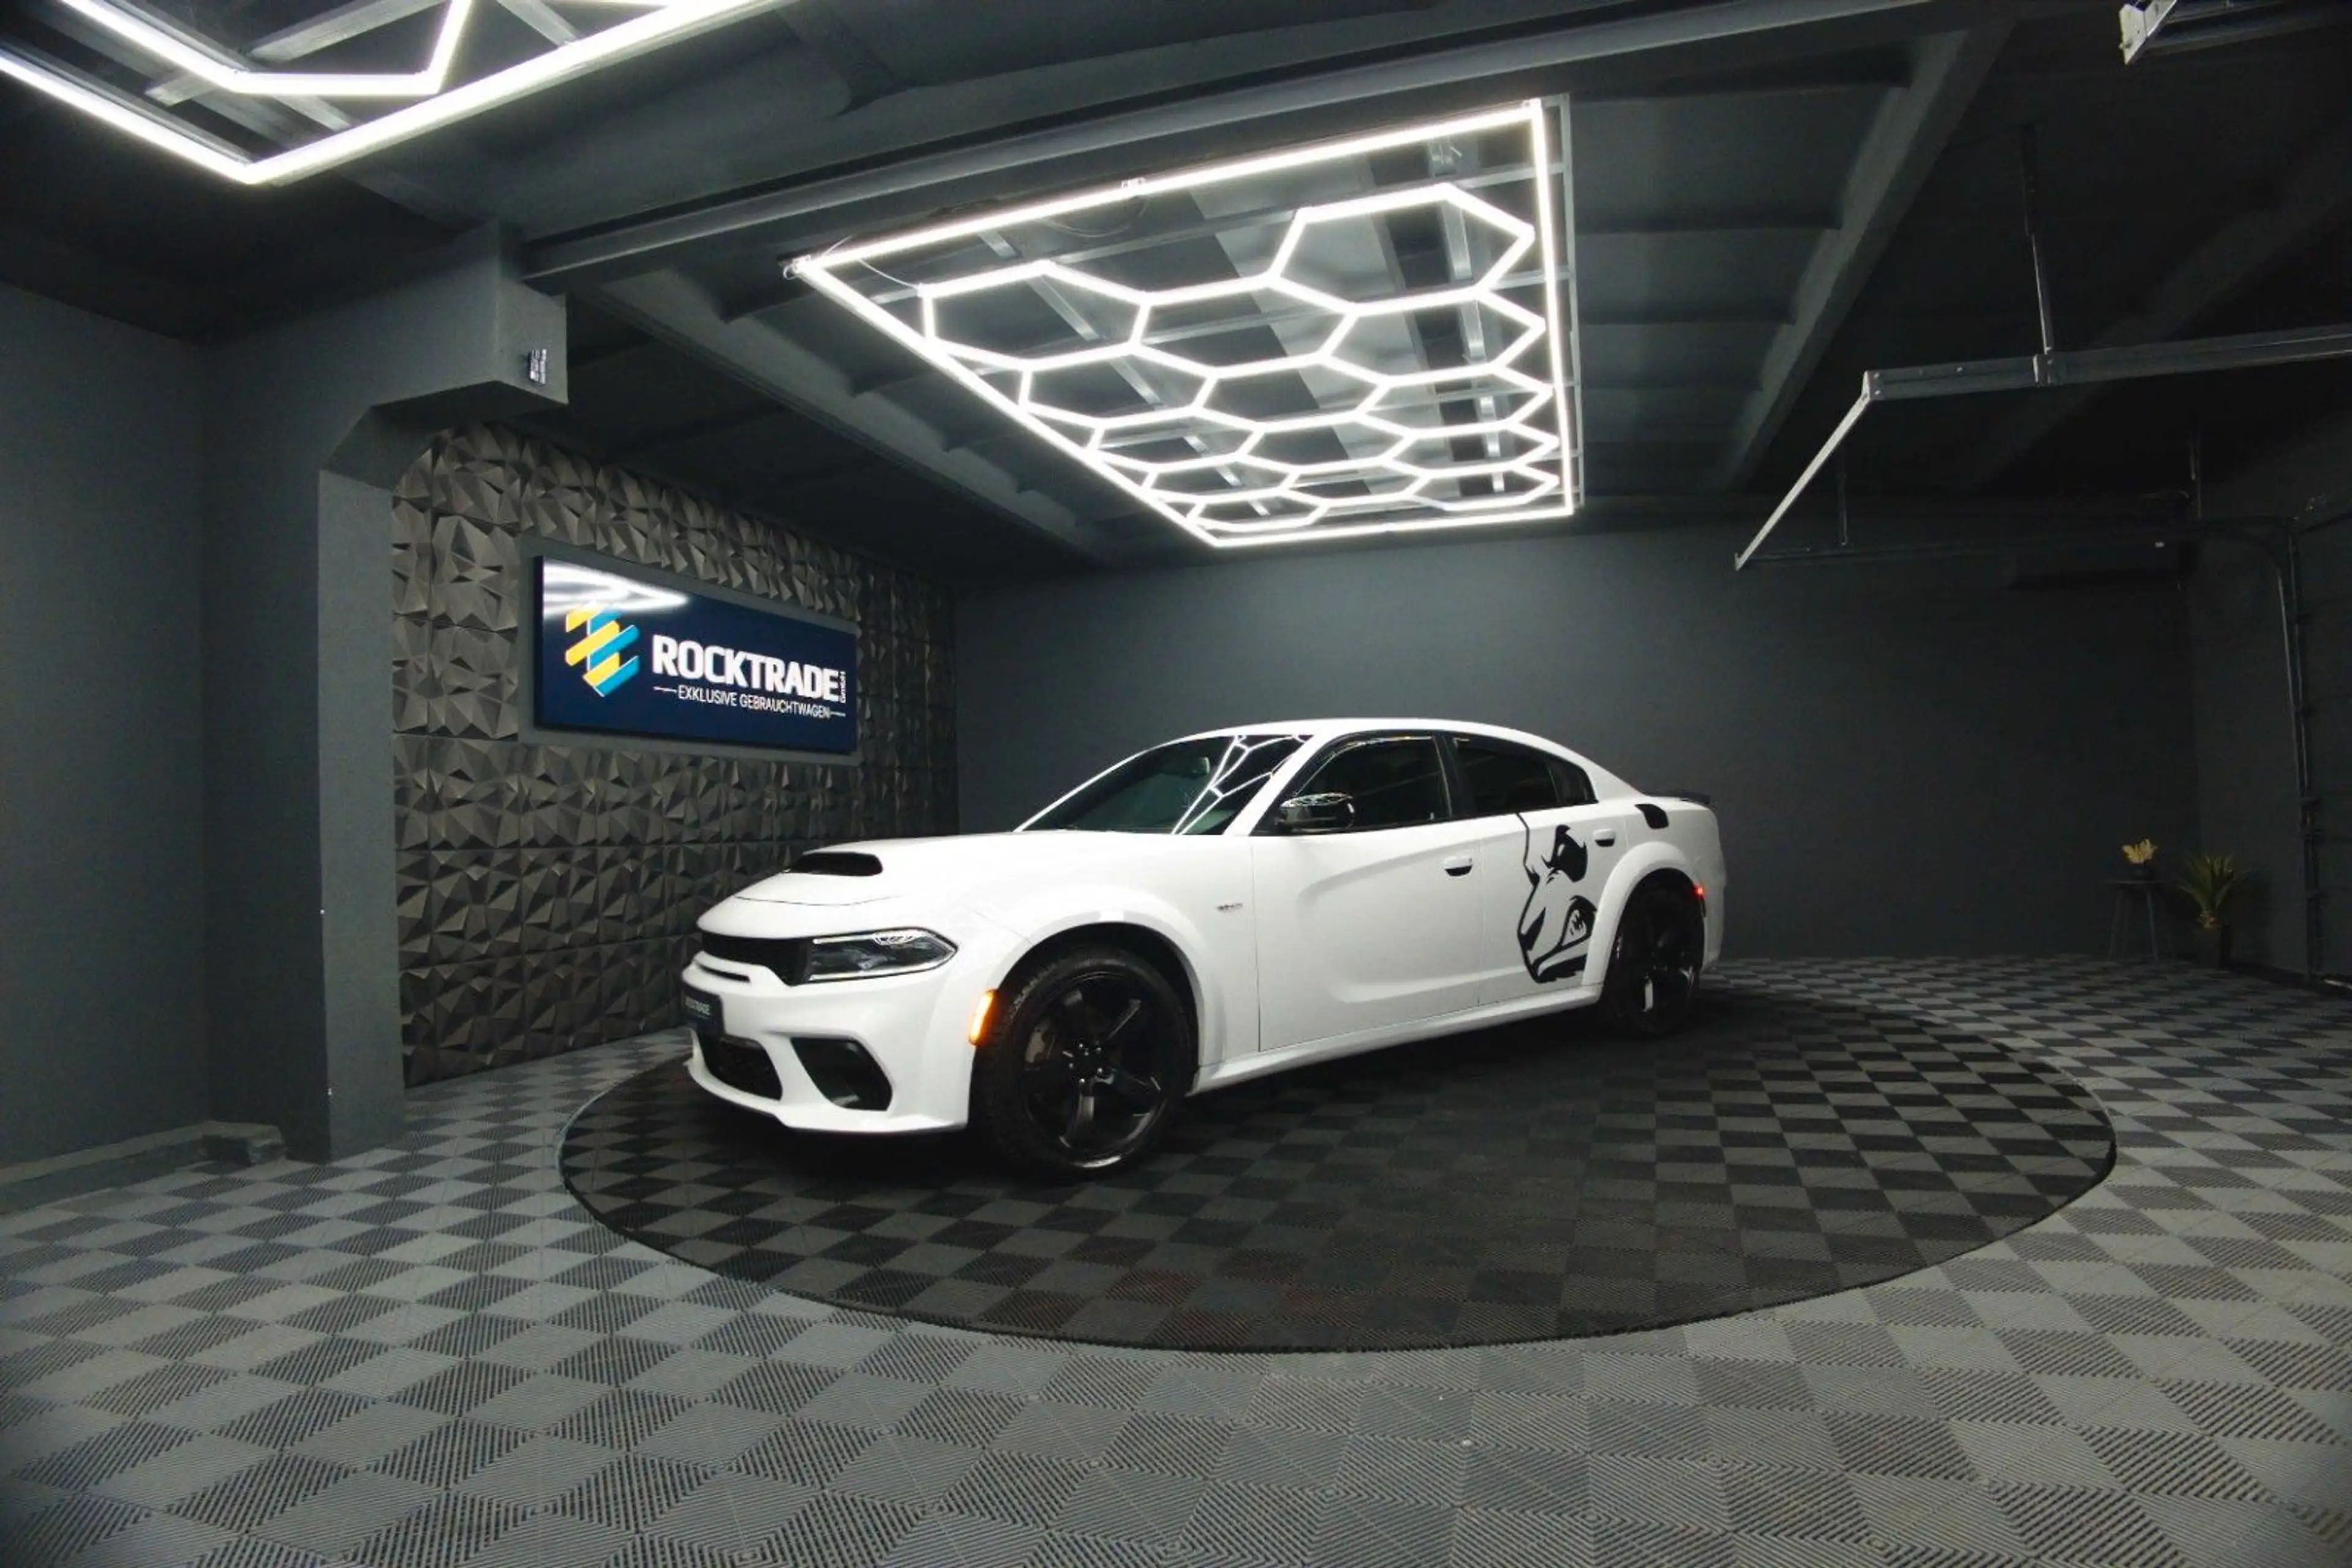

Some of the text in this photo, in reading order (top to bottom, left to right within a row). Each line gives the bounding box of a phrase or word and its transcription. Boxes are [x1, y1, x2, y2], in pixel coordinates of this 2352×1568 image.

[652, 634, 839, 702] ROCKTRADE
[678, 684, 831, 719] EXKLUSIVE GEBRAUCHTWAGEN
